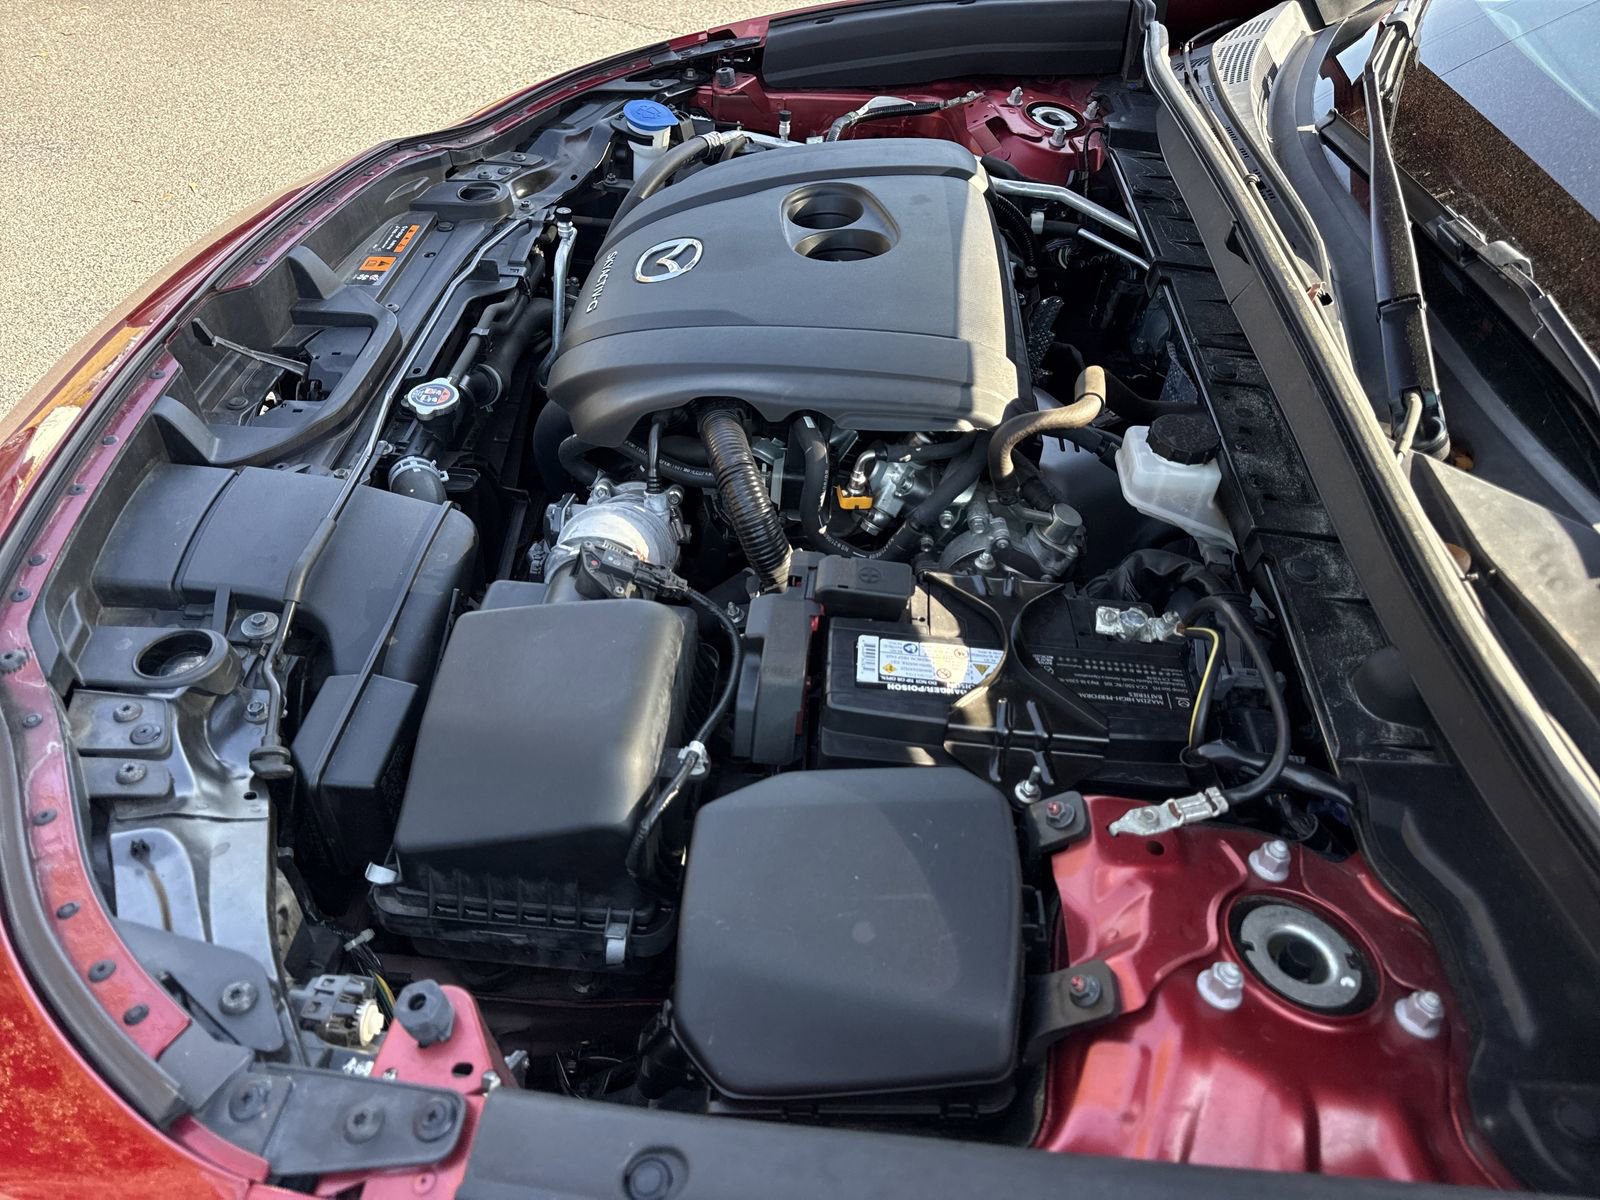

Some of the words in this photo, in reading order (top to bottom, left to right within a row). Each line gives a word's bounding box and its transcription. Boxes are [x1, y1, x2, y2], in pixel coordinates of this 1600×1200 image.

[586, 250, 618, 312] SKYACTIV-G
[1078, 693, 1134, 702] HIGH-PERFORM
[1128, 692, 1162, 700] BATTERIES
[1135, 697, 1164, 706] MAZDA
